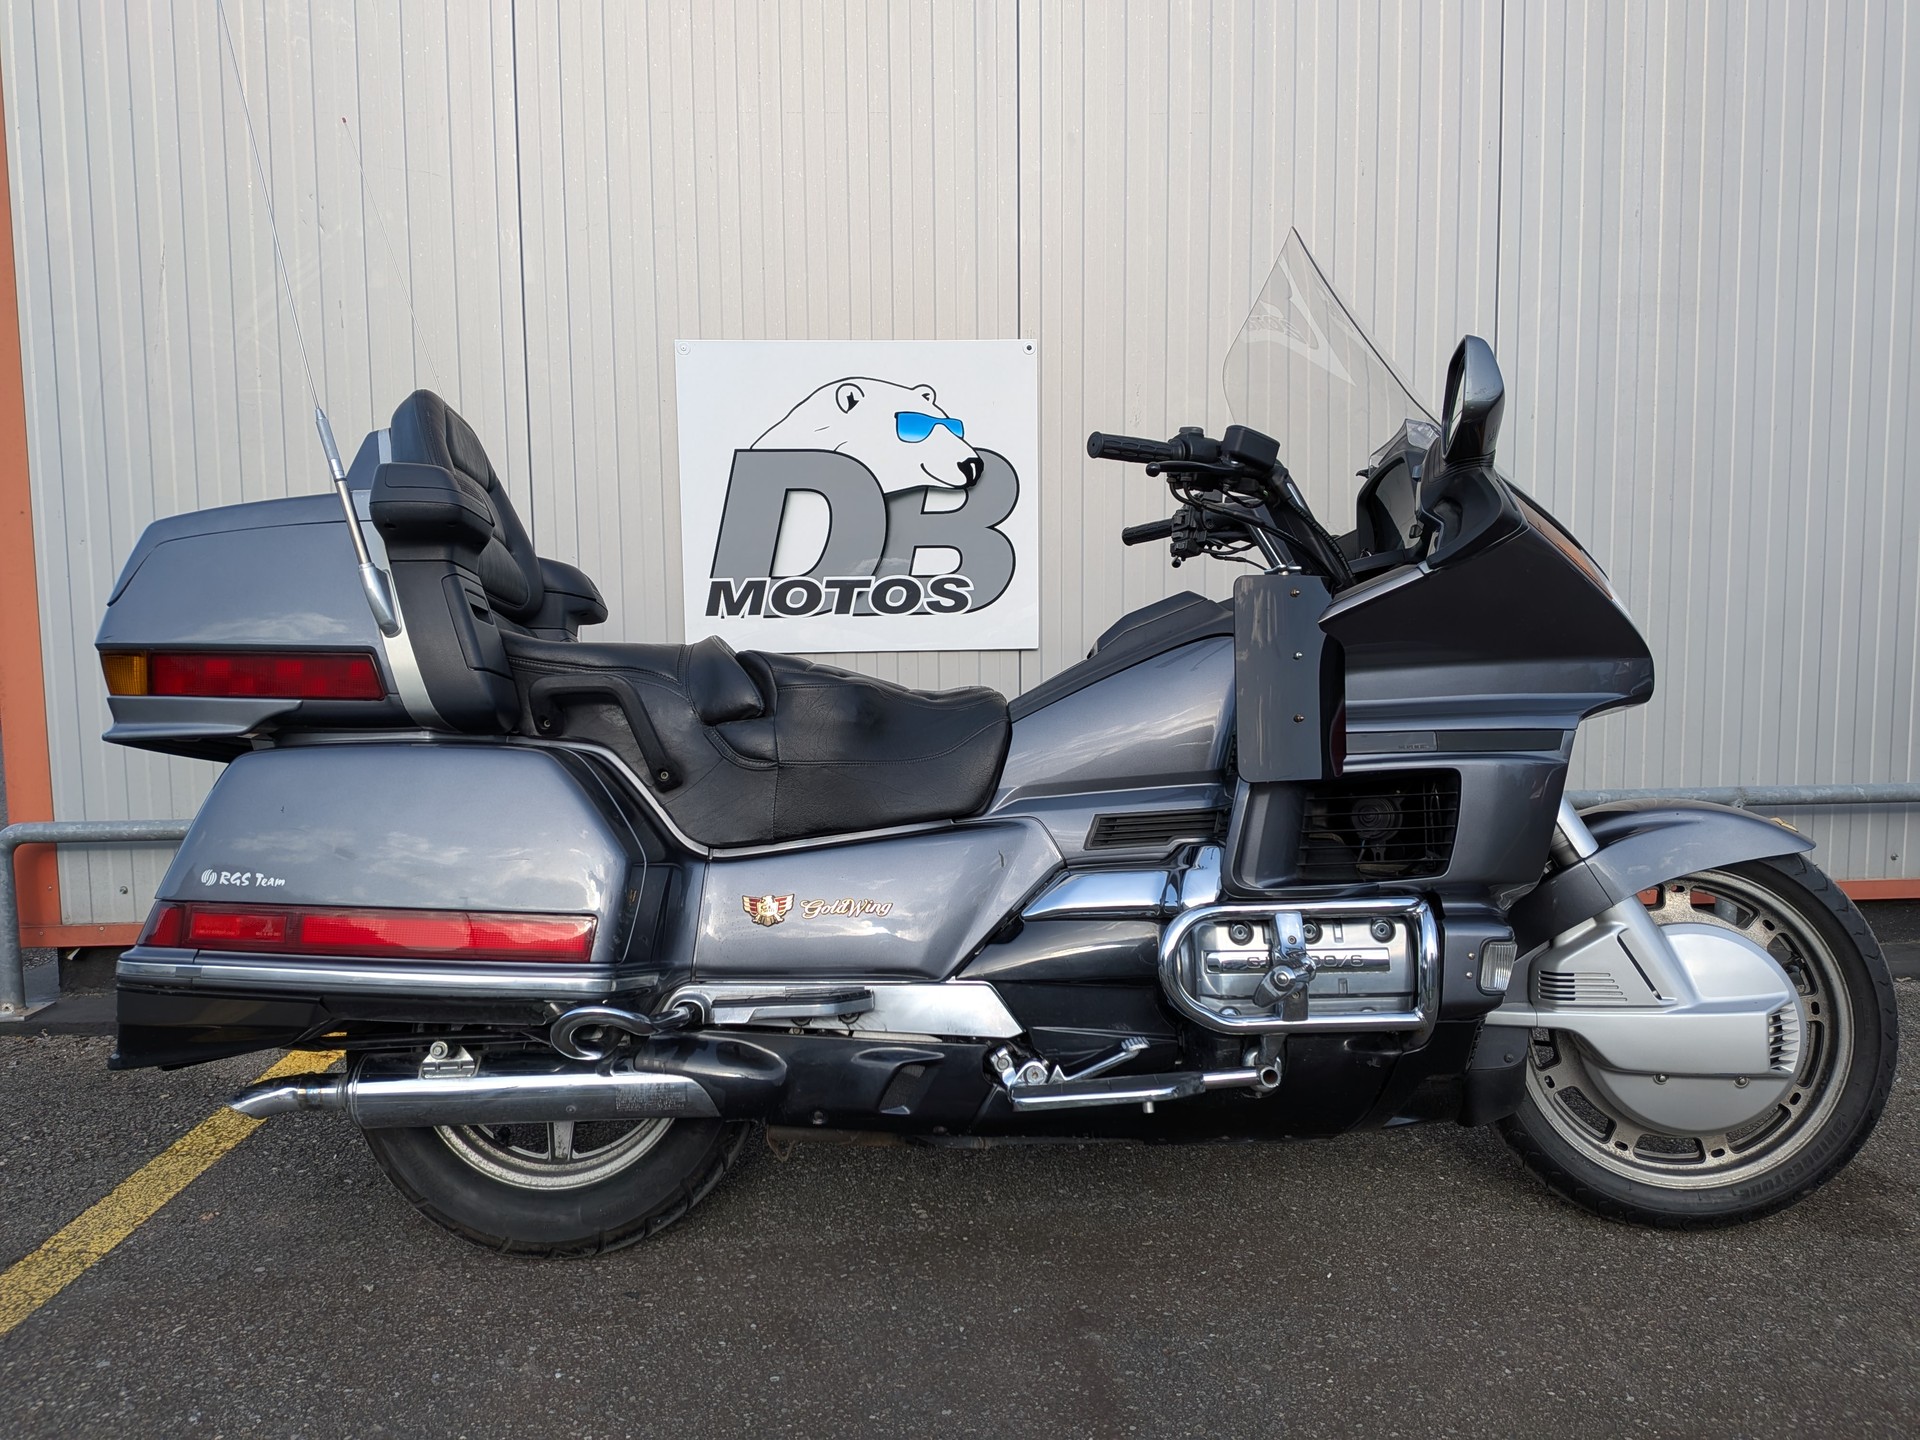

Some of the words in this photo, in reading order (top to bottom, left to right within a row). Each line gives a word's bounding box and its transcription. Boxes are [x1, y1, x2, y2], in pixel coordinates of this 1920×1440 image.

[709, 447, 1020, 617] DB
[704, 574, 975, 618] MOTOS
[219, 871, 251, 886] RGS
[255, 872, 286, 887] Team
